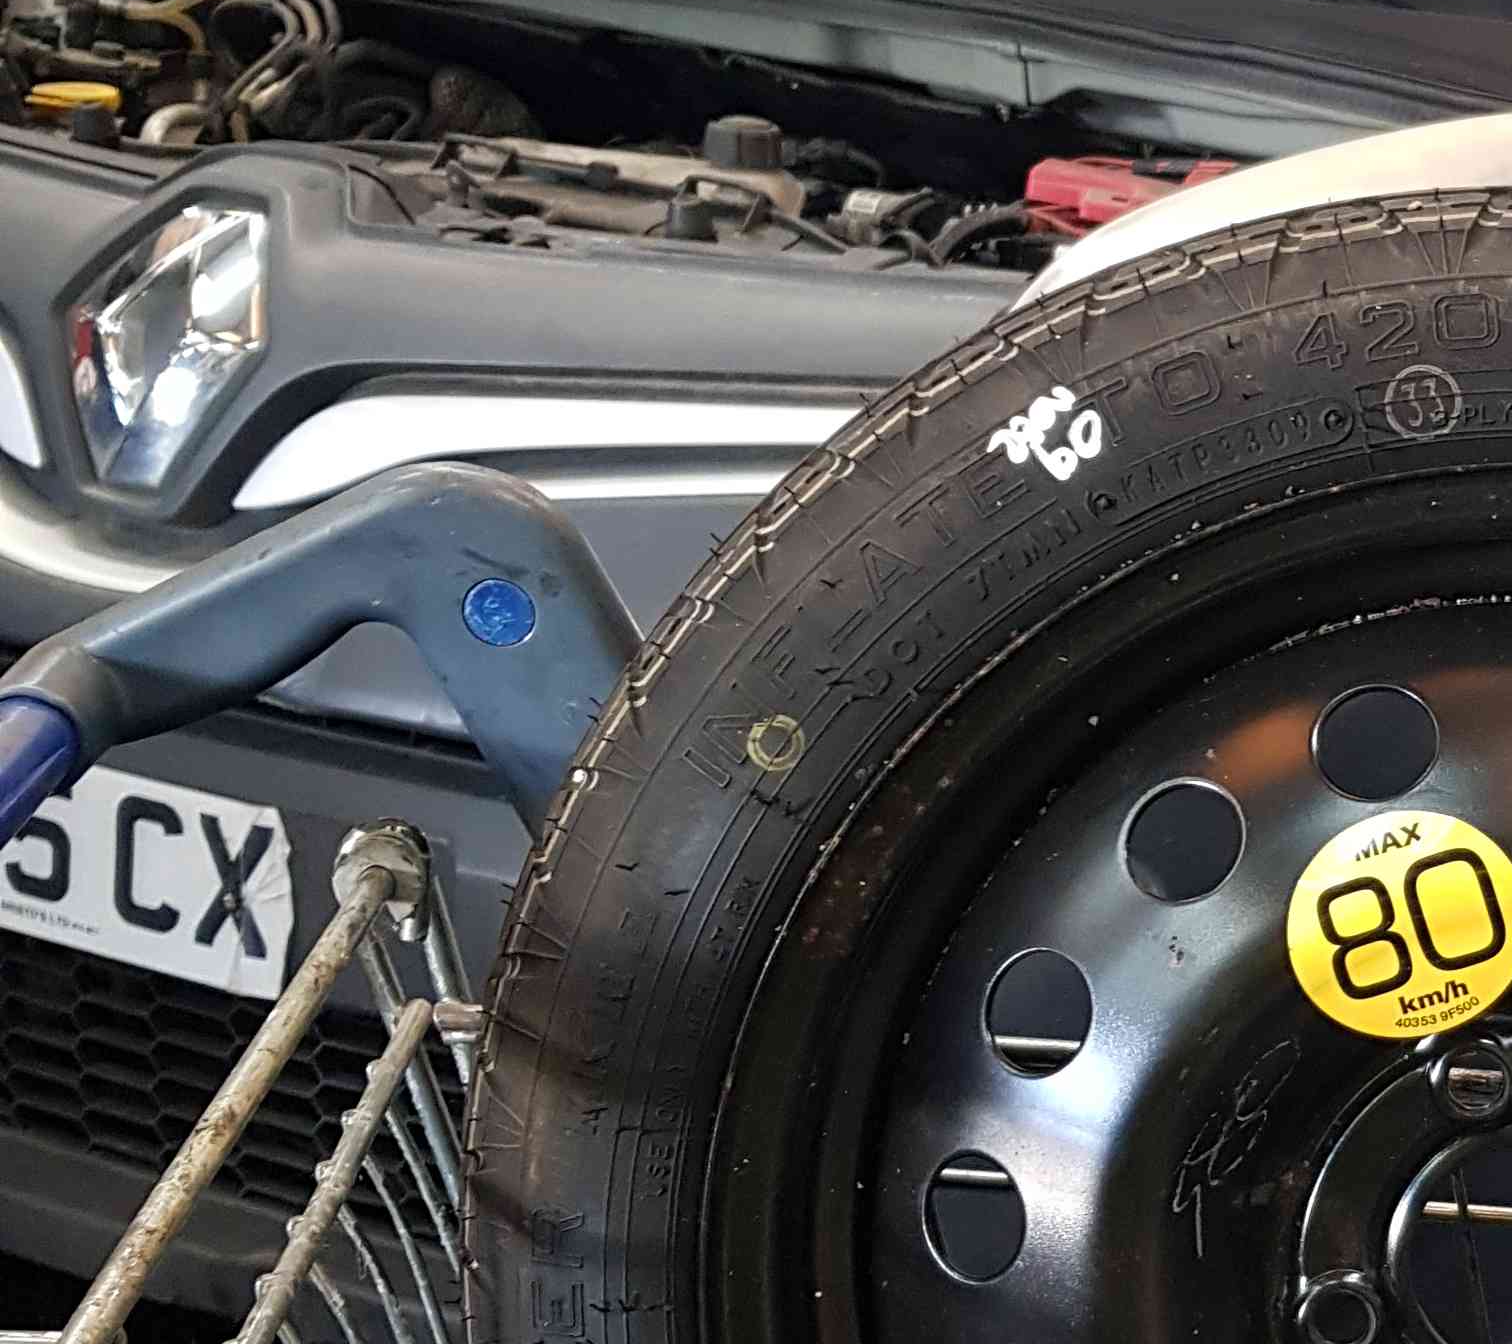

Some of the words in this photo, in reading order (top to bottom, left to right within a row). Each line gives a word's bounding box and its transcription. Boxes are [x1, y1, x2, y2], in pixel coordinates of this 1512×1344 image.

[1072, 349, 1223, 447] TO
[1294, 292, 1502, 369] 420
[114, 794, 276, 959] CX
[1354, 822, 1422, 862] MAX
[1317, 847, 1506, 1000] 80
[1394, 1013, 1438, 1029] 40353
[1440, 996, 1480, 1023] 9F500
[1397, 979, 1470, 1016] km/h
